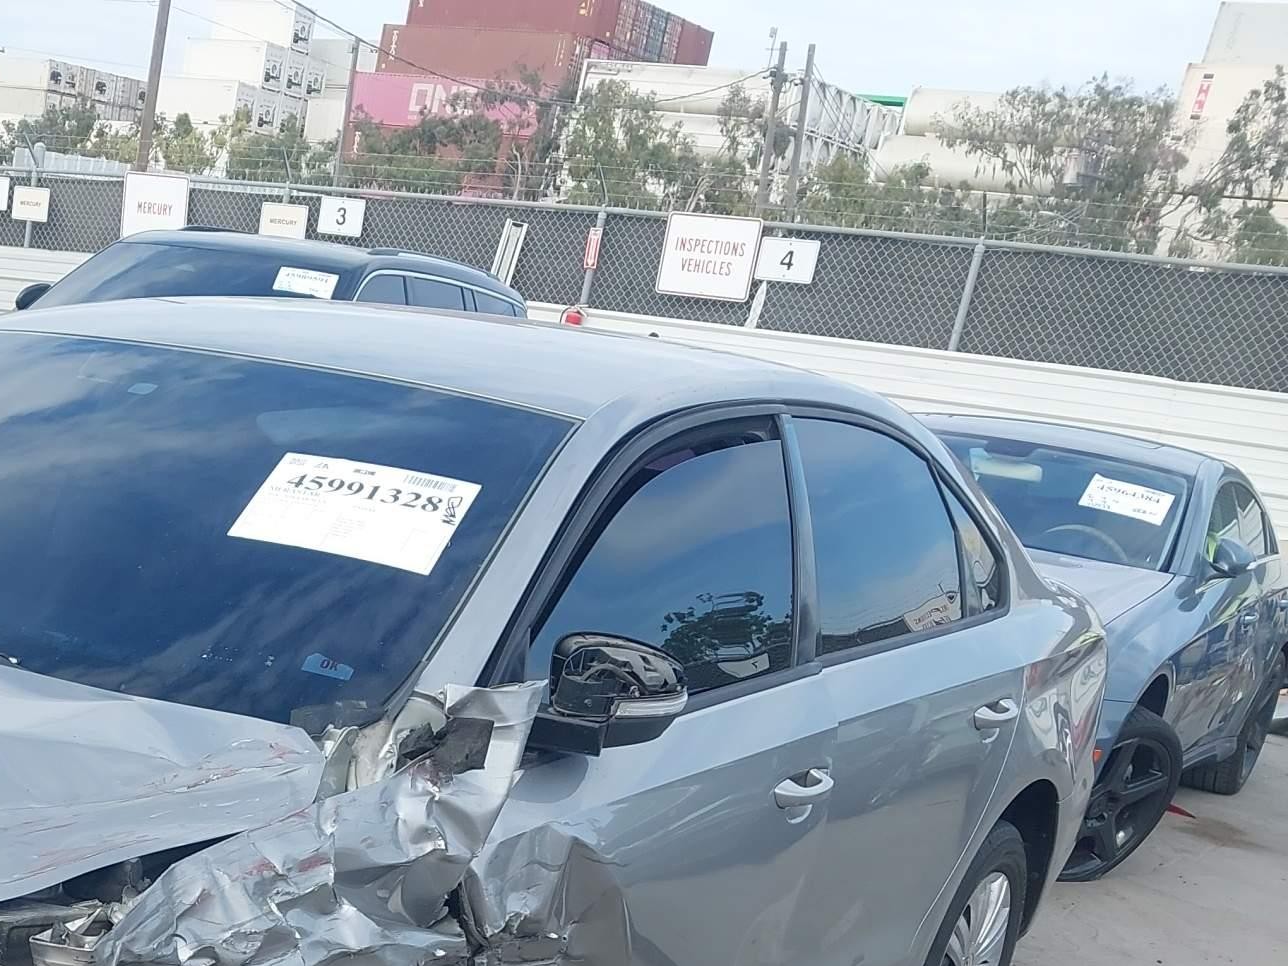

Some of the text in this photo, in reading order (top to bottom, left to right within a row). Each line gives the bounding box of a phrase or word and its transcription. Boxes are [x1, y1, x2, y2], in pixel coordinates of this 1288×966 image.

[137, 201, 173, 217] MERCURY
[335, 207, 347, 225] 3
[270, 217, 297, 226] MERCURY
[675, 236, 746, 257] INSPECTIONS
[681, 257, 732, 276] VEHICLES
[779, 250, 794, 271] 4
[286, 473, 443, 513] 45991328
